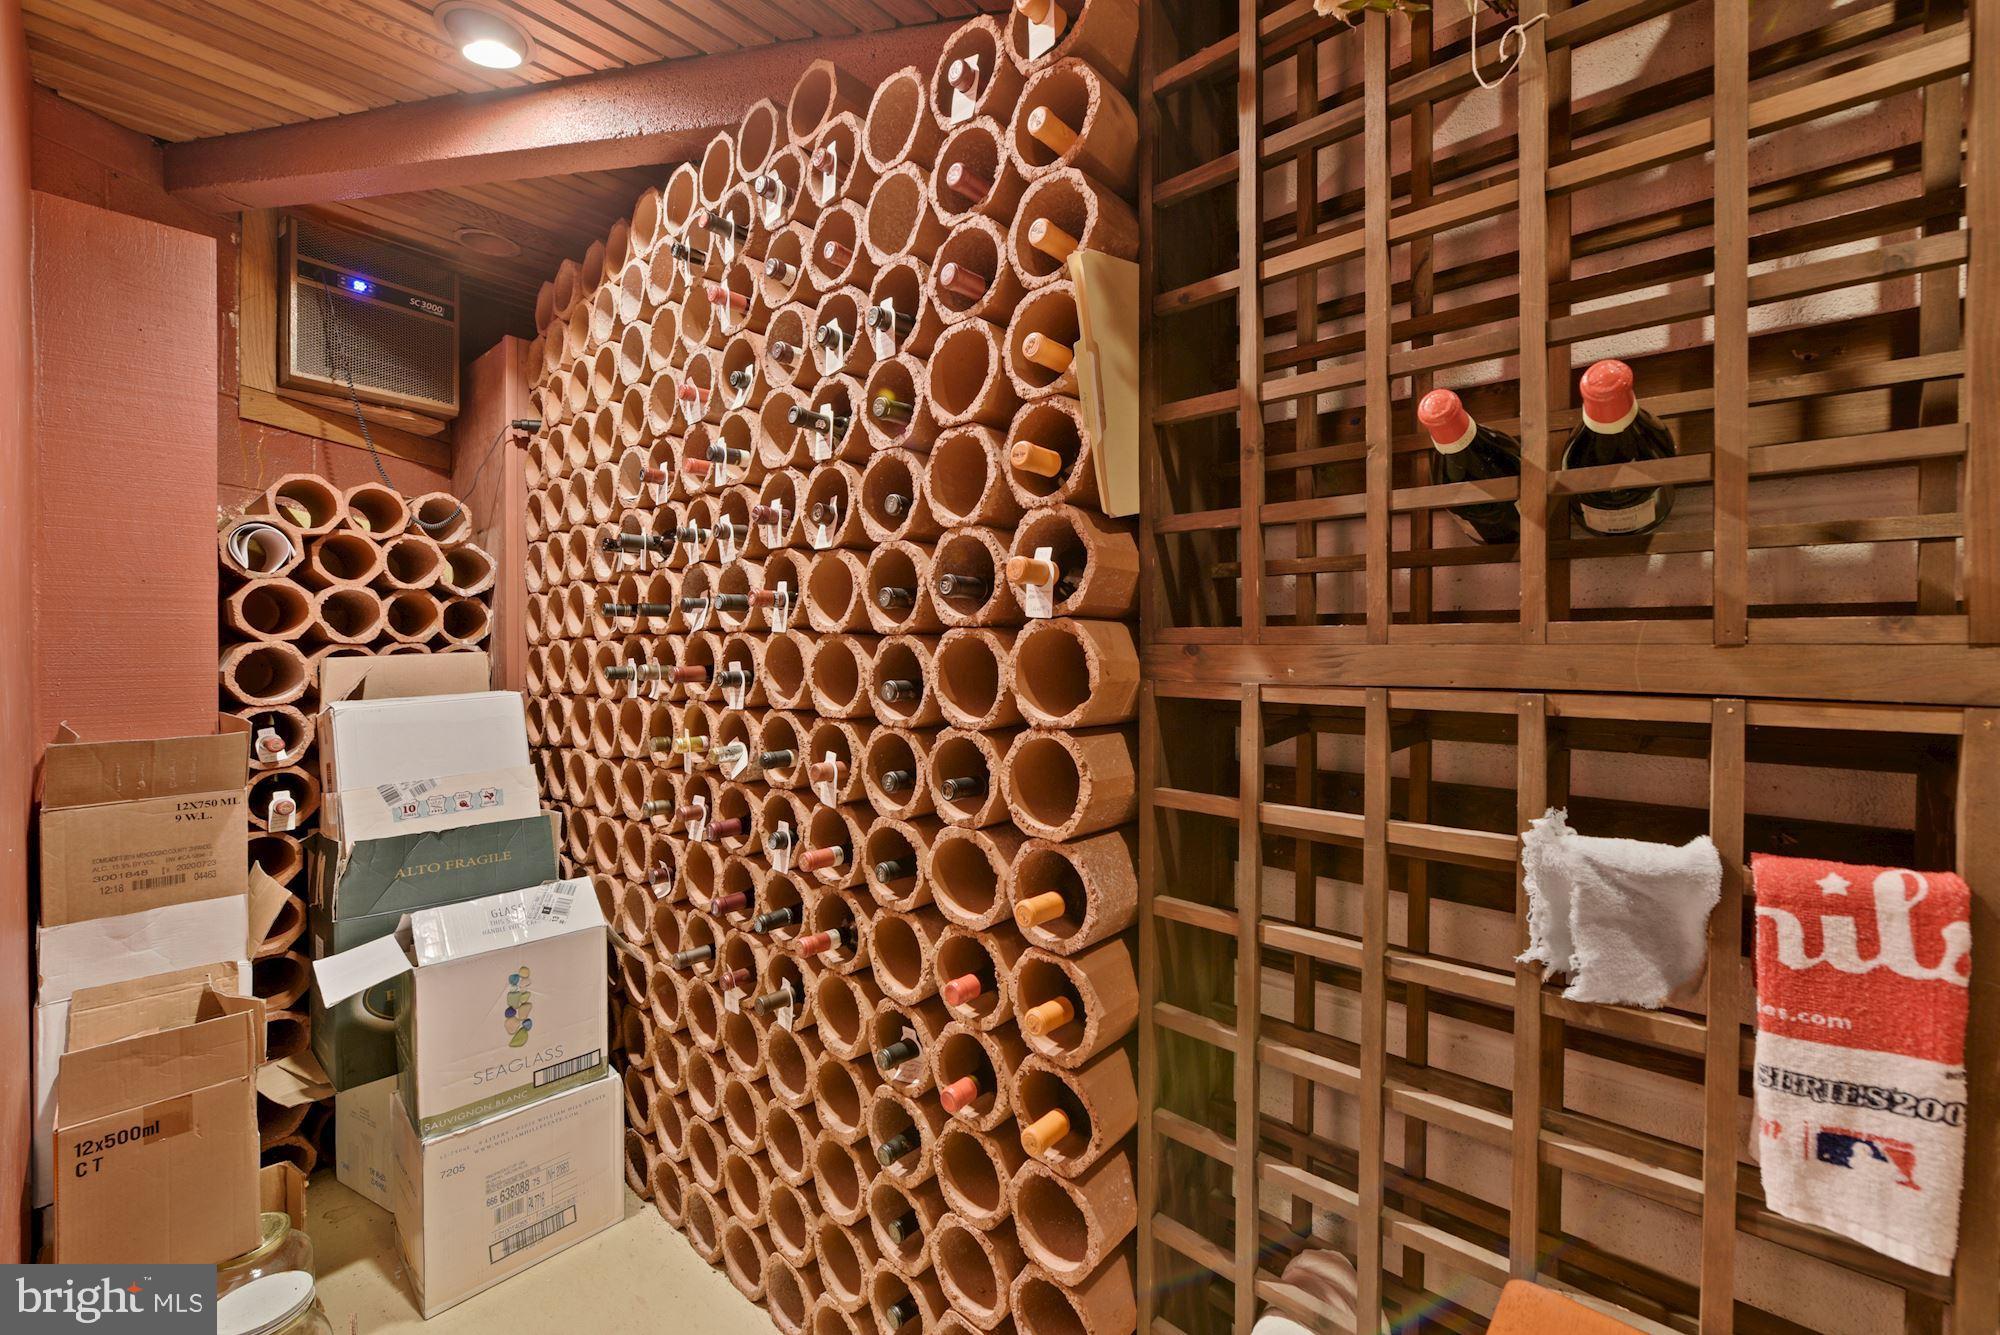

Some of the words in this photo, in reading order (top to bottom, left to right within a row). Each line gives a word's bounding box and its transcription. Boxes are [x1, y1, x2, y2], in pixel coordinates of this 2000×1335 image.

[176, 799, 218, 811] 12X750
[220, 797, 241, 806] ML
[403, 804, 416, 815] 10
[175, 814, 182, 823] 9
[185, 812, 213, 821] W.L.
[394, 861, 441, 879] ALTO
[445, 851, 512, 870] FRAGILE
[92, 869, 149, 883] 3001848
[473, 1045, 565, 1086] SEAGLASS
[424, 1103, 492, 1132] SAUVIGNON
[495, 1090, 529, 1108] BLANC
[74, 1120, 160, 1158] 12x500ml
[75, 1162, 87, 1178] C
[92, 1157, 104, 1172] T
[440, 1164, 465, 1179] 7205
[499, 1179, 530, 1203] 638088
